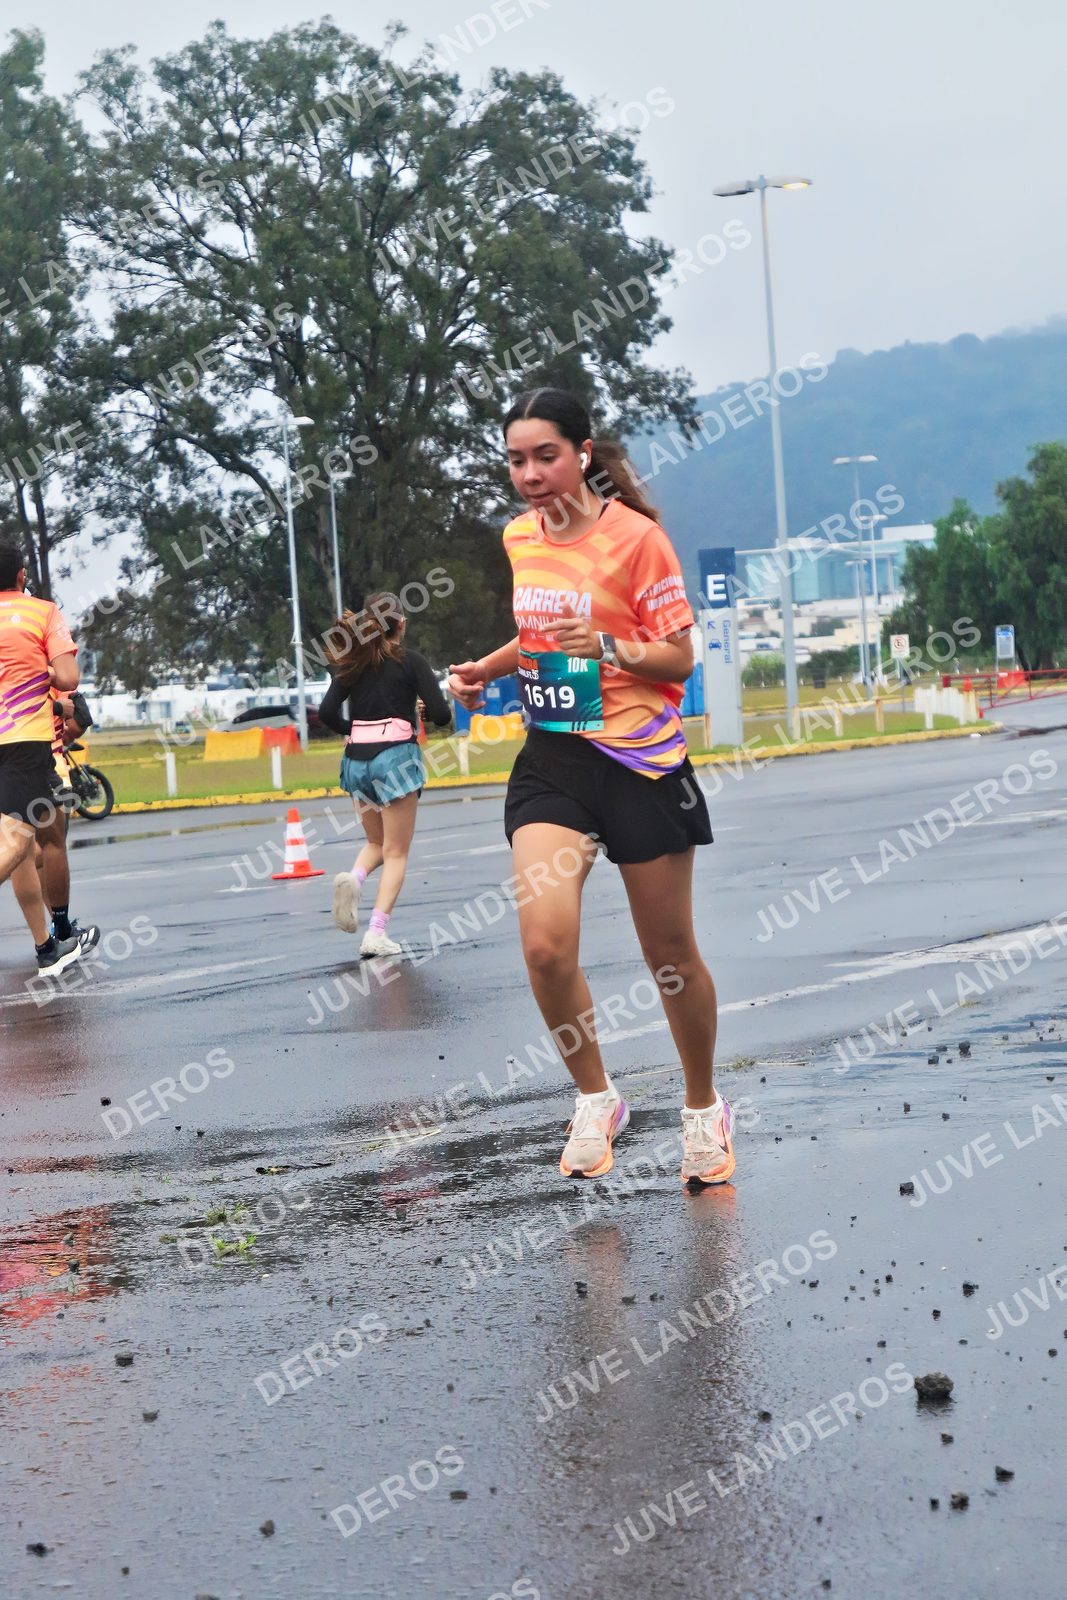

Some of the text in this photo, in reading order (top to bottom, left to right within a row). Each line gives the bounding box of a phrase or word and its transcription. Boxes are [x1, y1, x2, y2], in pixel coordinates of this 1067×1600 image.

[706, 574, 727, 600] E
[722, 619, 733, 664] General
[567, 657, 588, 673] 10K
[524, 683, 576, 709] 1619
